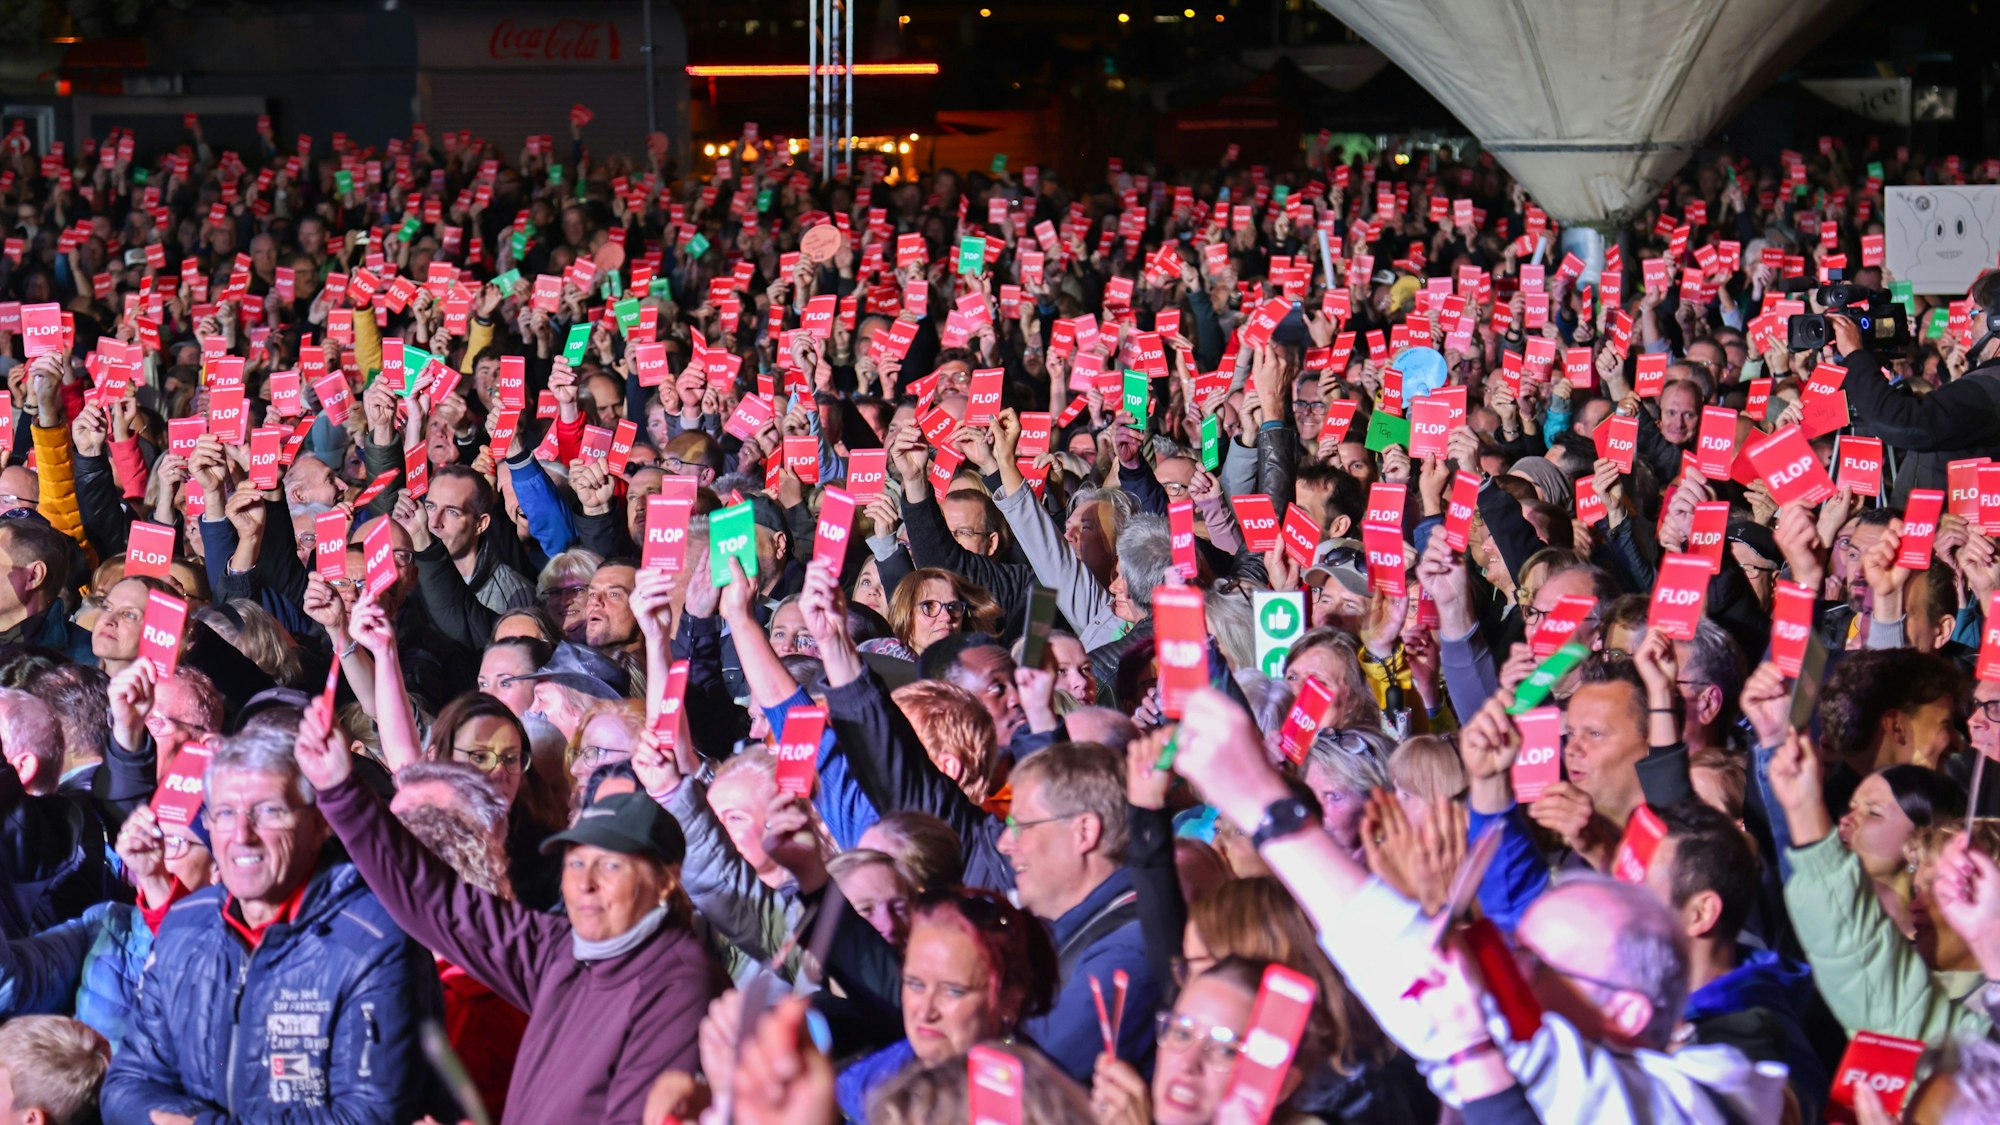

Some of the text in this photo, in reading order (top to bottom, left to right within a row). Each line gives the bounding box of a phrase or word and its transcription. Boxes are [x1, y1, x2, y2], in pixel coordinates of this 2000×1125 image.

[899, 246, 918, 255] FLOP
[1864, 246, 1882, 255] FLOP
[1352, 266, 1371, 274] FLOP
[428, 275, 449, 284] FLOP
[573, 270, 591, 281] FLOP
[1646, 272, 1665, 281] FLOP
[353, 277, 375, 294] FLOP
[1285, 280, 1304, 288] FLOP
[1460, 278, 1479, 287] FLOP
[1522, 278, 1542, 287] FLOP
[326, 284, 345, 292] FLOP
[536, 289, 557, 298] FLOP
[1108, 290, 1128, 299] FLOP
[878, 298, 898, 307] FLOP
[963, 305, 985, 318] FLOP
[1325, 306, 1345, 315] FLOP
[1442, 308, 1460, 318] FLOP
[0, 315, 19, 323] FLOP
[446, 313, 466, 321] FLOP
[806, 312, 831, 321] FLOP
[1493, 314, 1513, 323] FLOP
[26, 325, 59, 336] FLOP
[140, 327, 158, 336] FLOP
[329, 323, 350, 331] FLOP
[949, 325, 968, 336] FLOP
[1157, 323, 1178, 332] FLOP
[1076, 328, 1098, 338] FLOP
[1410, 330, 1429, 339] FLOP
[889, 334, 910, 344] FLOP
[872, 340, 885, 350] FLO
[1371, 344, 1386, 354] FLOP
[205, 350, 225, 358] FLOP
[1143, 350, 1163, 360] FLOP
[1332, 348, 1350, 357] FLOP
[1307, 359, 1327, 367] FLOP
[1527, 354, 1550, 364] FLOP
[303, 362, 324, 370] FLOP
[384, 360, 402, 369] FLOP
[640, 359, 664, 370] FLOP
[709, 364, 727, 372] FLOP
[1568, 364, 1588, 373] FLOP
[403, 367, 414, 376] OP
[1075, 366, 1098, 377] FLOP
[1639, 371, 1663, 381] FLOP
[105, 379, 126, 388] FLOP
[216, 377, 239, 386] FLOP
[429, 368, 447, 394] FLOP
[502, 378, 521, 387] FLOP
[1101, 384, 1121, 393] FLOP
[1197, 385, 1212, 396] FLO
[1808, 382, 1835, 395] FLOP
[273, 389, 298, 399] FLOP
[324, 389, 348, 407] FLOP
[971, 393, 999, 404] FLOP
[1749, 395, 1767, 404] FLOP
[212, 408, 239, 420] FLOP
[539, 405, 557, 413] FLOP
[736, 409, 760, 426] FLOP
[1327, 417, 1349, 427] FLOP
[927, 418, 951, 439] FLOP
[1414, 423, 1446, 435] FLOP
[1020, 430, 1048, 440] FLOP
[173, 439, 200, 448] FLO
[1609, 438, 1632, 450] FLOP
[1701, 436, 1731, 450] FLOP
[582, 446, 606, 458] FLOP
[252, 453, 276, 465] FLOP
[788, 455, 815, 466] FLOP
[1844, 457, 1878, 471] FLOP
[851, 472, 882, 482] FLOP
[932, 464, 950, 480] FLOP
[1769, 456, 1812, 489] FLOP
[1952, 487, 1979, 501] FLO
[1980, 493, 2000, 506] FLO
[1369, 510, 1399, 521] FLOP
[1450, 502, 1471, 519] FLOP
[1243, 519, 1275, 530] FLOP
[1904, 522, 1933, 537] FLOP
[649, 528, 684, 543] FLOP
[818, 520, 845, 541] FLOP
[1286, 524, 1313, 549] FLOP
[1692, 532, 1721, 545] FLOP
[319, 539, 343, 554] FLOP
[718, 535, 747, 555] TOP
[131, 549, 167, 565] FLOP
[368, 544, 390, 571] FLOP
[1369, 550, 1401, 567] FLOP
[1657, 588, 1700, 605] FLOP
[1542, 619, 1576, 632] FLOP
[143, 625, 175, 648] FLOP
[1292, 707, 1316, 732] FLOP
[780, 742, 814, 760] FLOP
[1517, 748, 1553, 765] LOP
